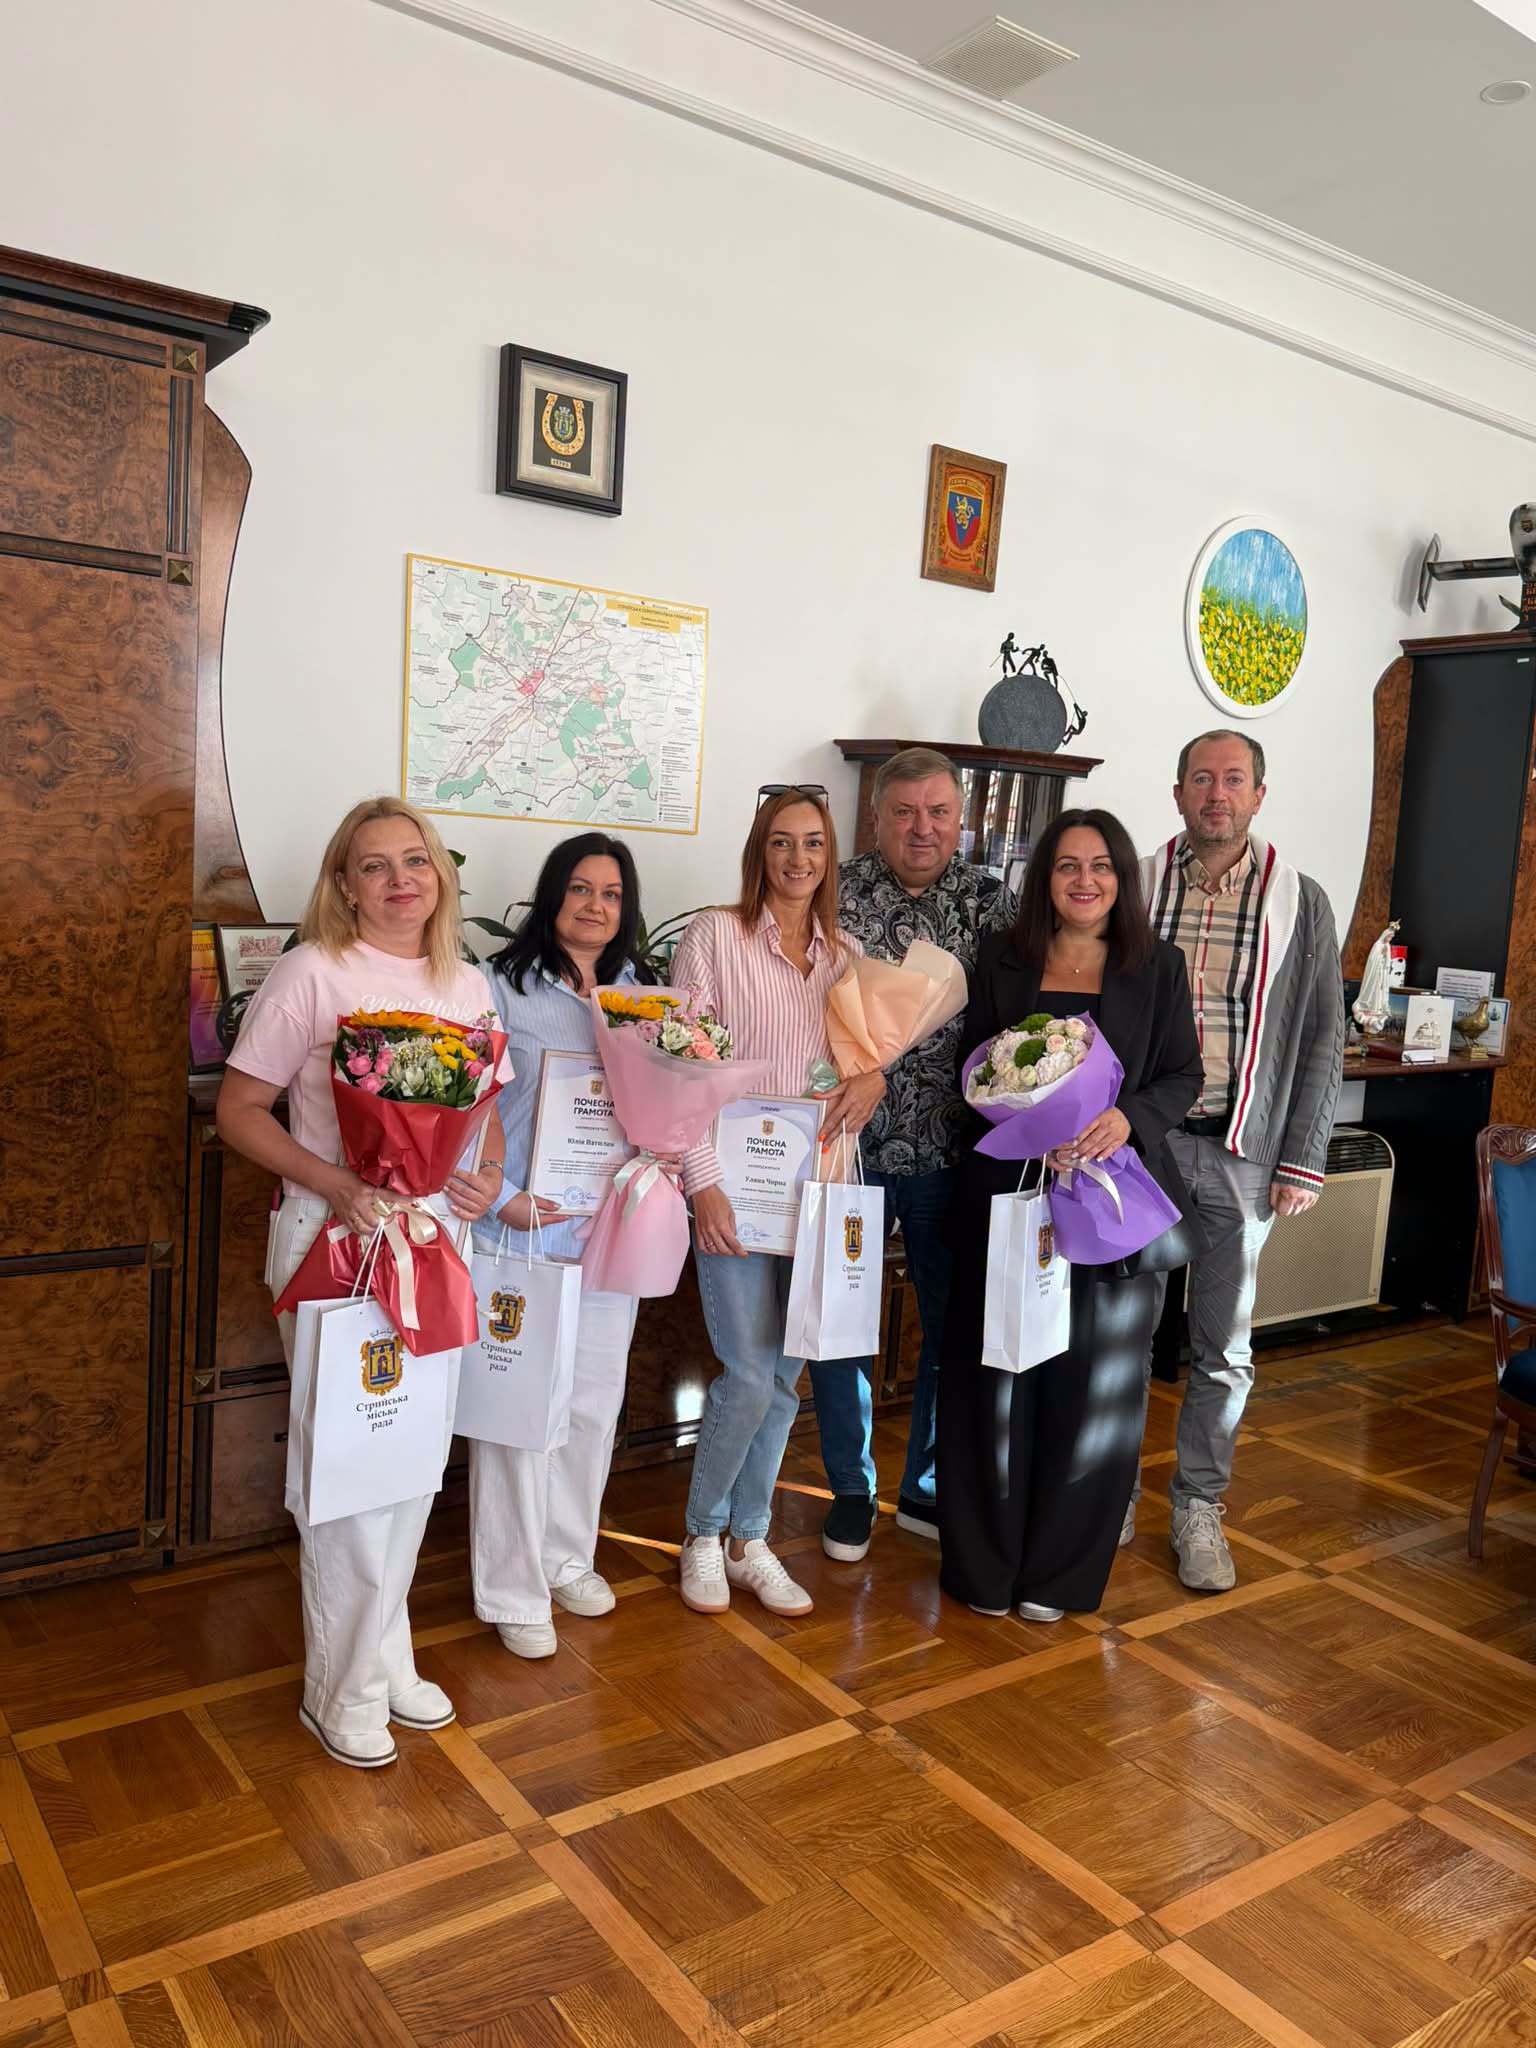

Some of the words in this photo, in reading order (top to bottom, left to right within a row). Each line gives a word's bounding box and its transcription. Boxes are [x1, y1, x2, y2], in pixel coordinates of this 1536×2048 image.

[574, 1097, 615, 1108] ПОЧЕСНА
[573, 1107, 614, 1118] ГРАМОТА
[746, 1137, 787, 1148] ПОЧЕСНА
[746, 1146, 785, 1157] ГРАМОТА
[480, 1342, 523, 1357] Стрийська
[487, 1353, 513, 1364] міська
[489, 1362, 508, 1373] рада
[356, 1394, 409, 1413] Стрийська
[366, 1406, 399, 1420] міська
[371, 1418, 393, 1432] рада
